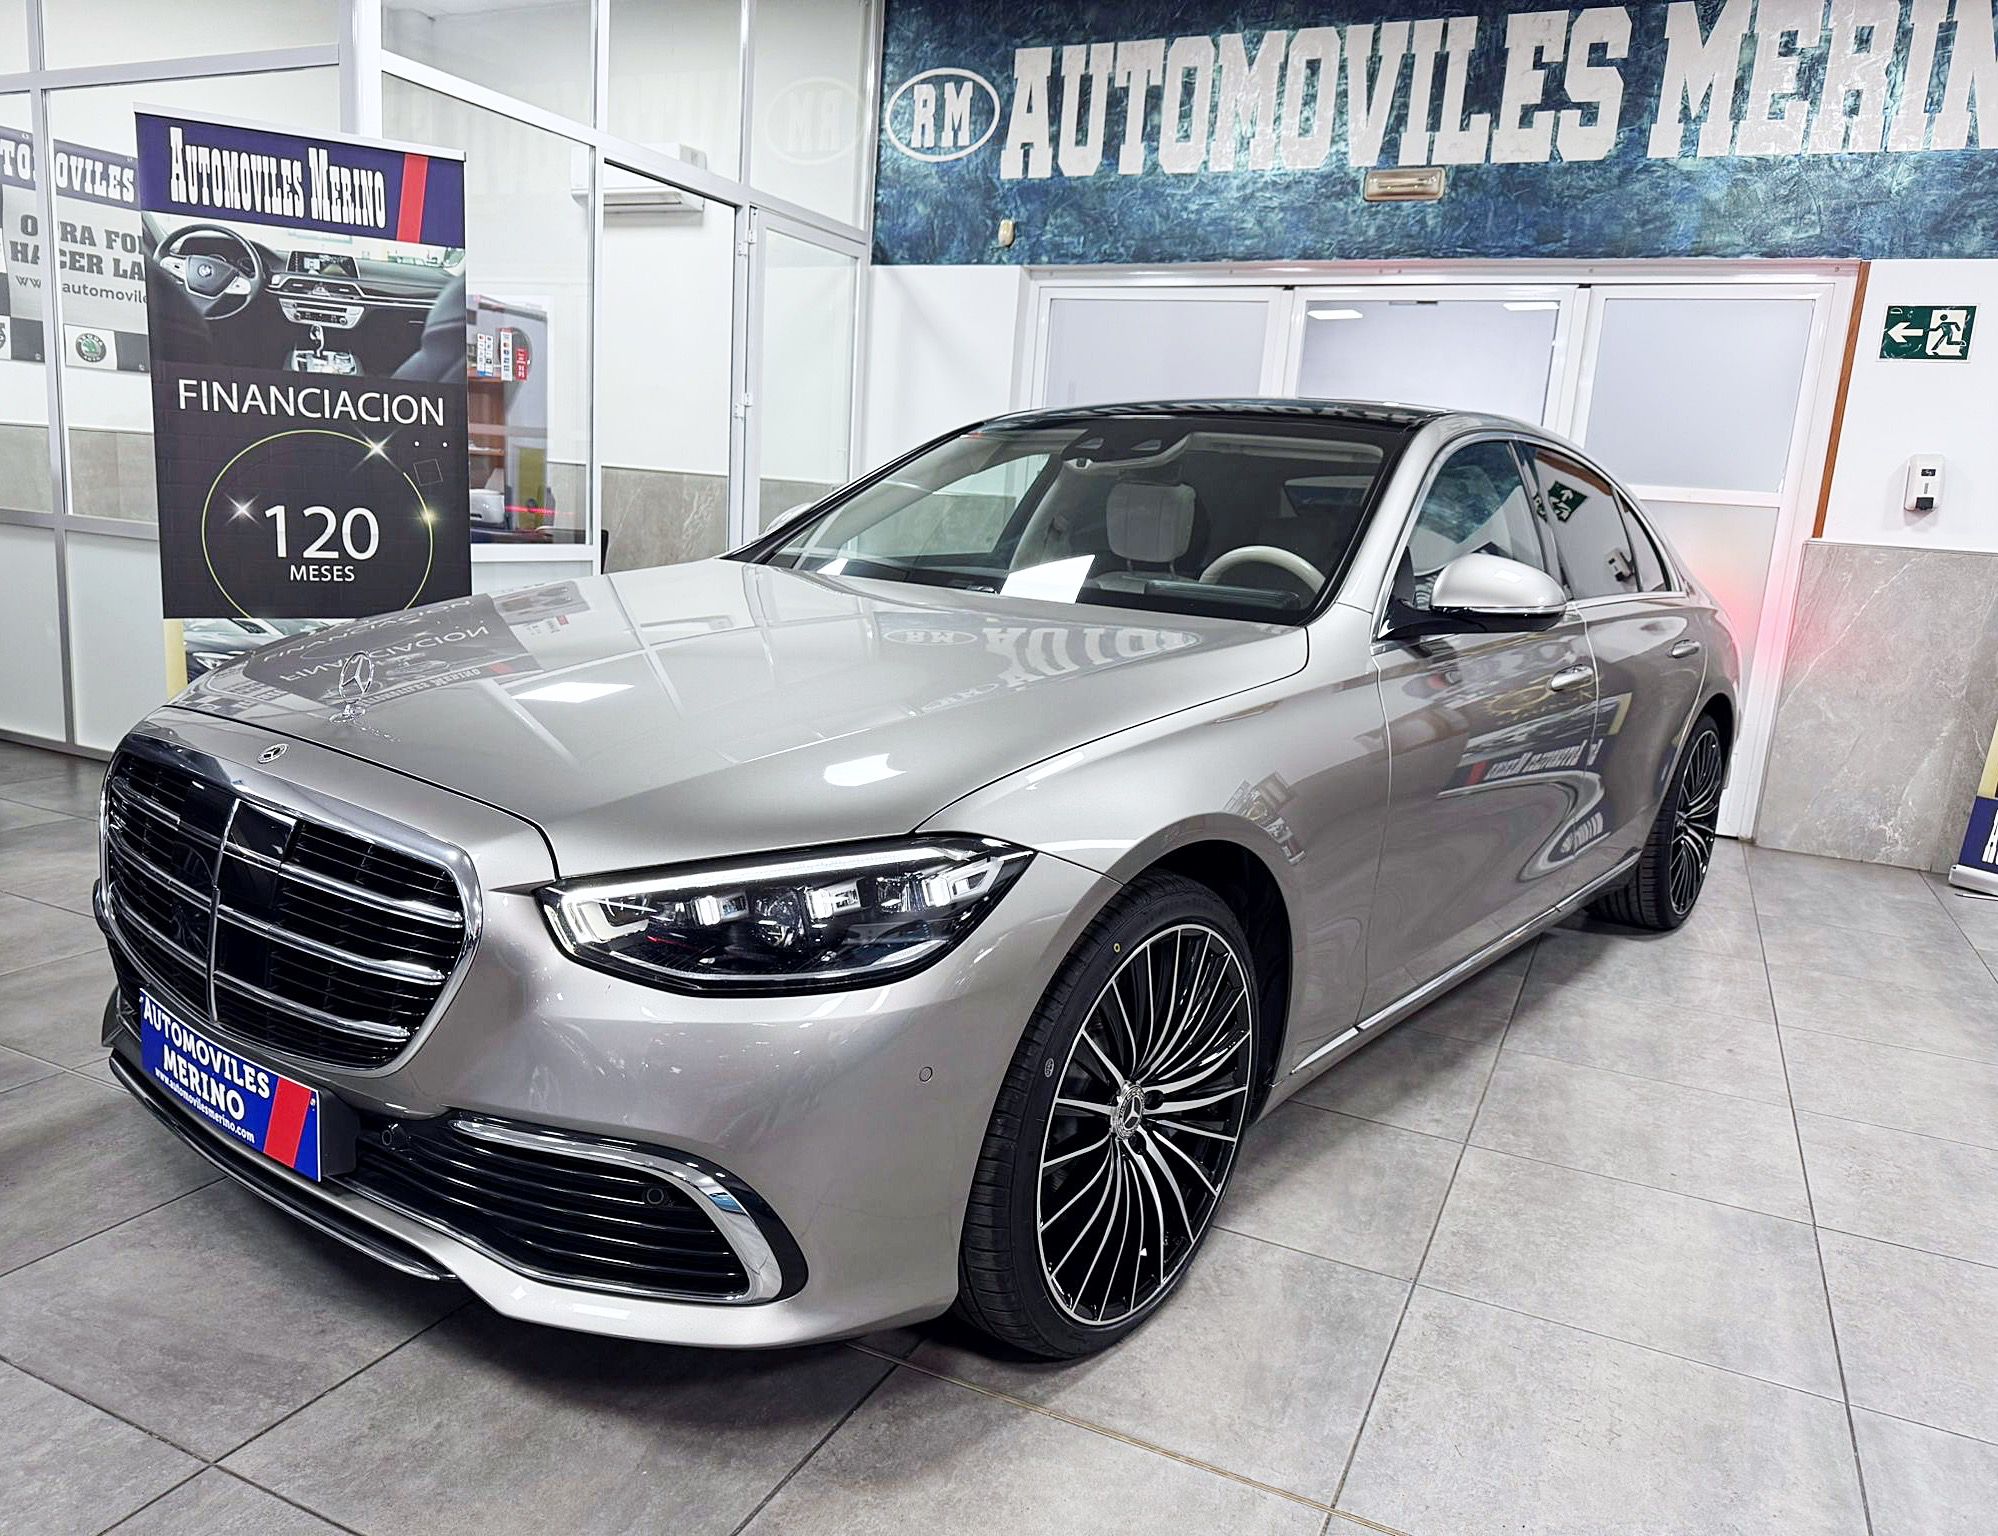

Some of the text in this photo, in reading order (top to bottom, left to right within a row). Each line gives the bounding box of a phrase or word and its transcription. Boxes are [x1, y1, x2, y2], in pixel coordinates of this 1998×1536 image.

[910, 81, 974, 149] RM
[1000, 6, 1633, 180] AUTOMOVILES
[169, 126, 386, 229] AUTOMOVILES MERINO
[112, 257, 146, 282] LA
[178, 378, 444, 427] FINANCIACION
[264, 504, 380, 561] 120
[289, 564, 356, 582] MESES
[143, 996, 271, 1099] AUTOMOVILES
[163, 1043, 245, 1121] MERINO
[154, 1066, 256, 1144] www.automovilesmerino.com
